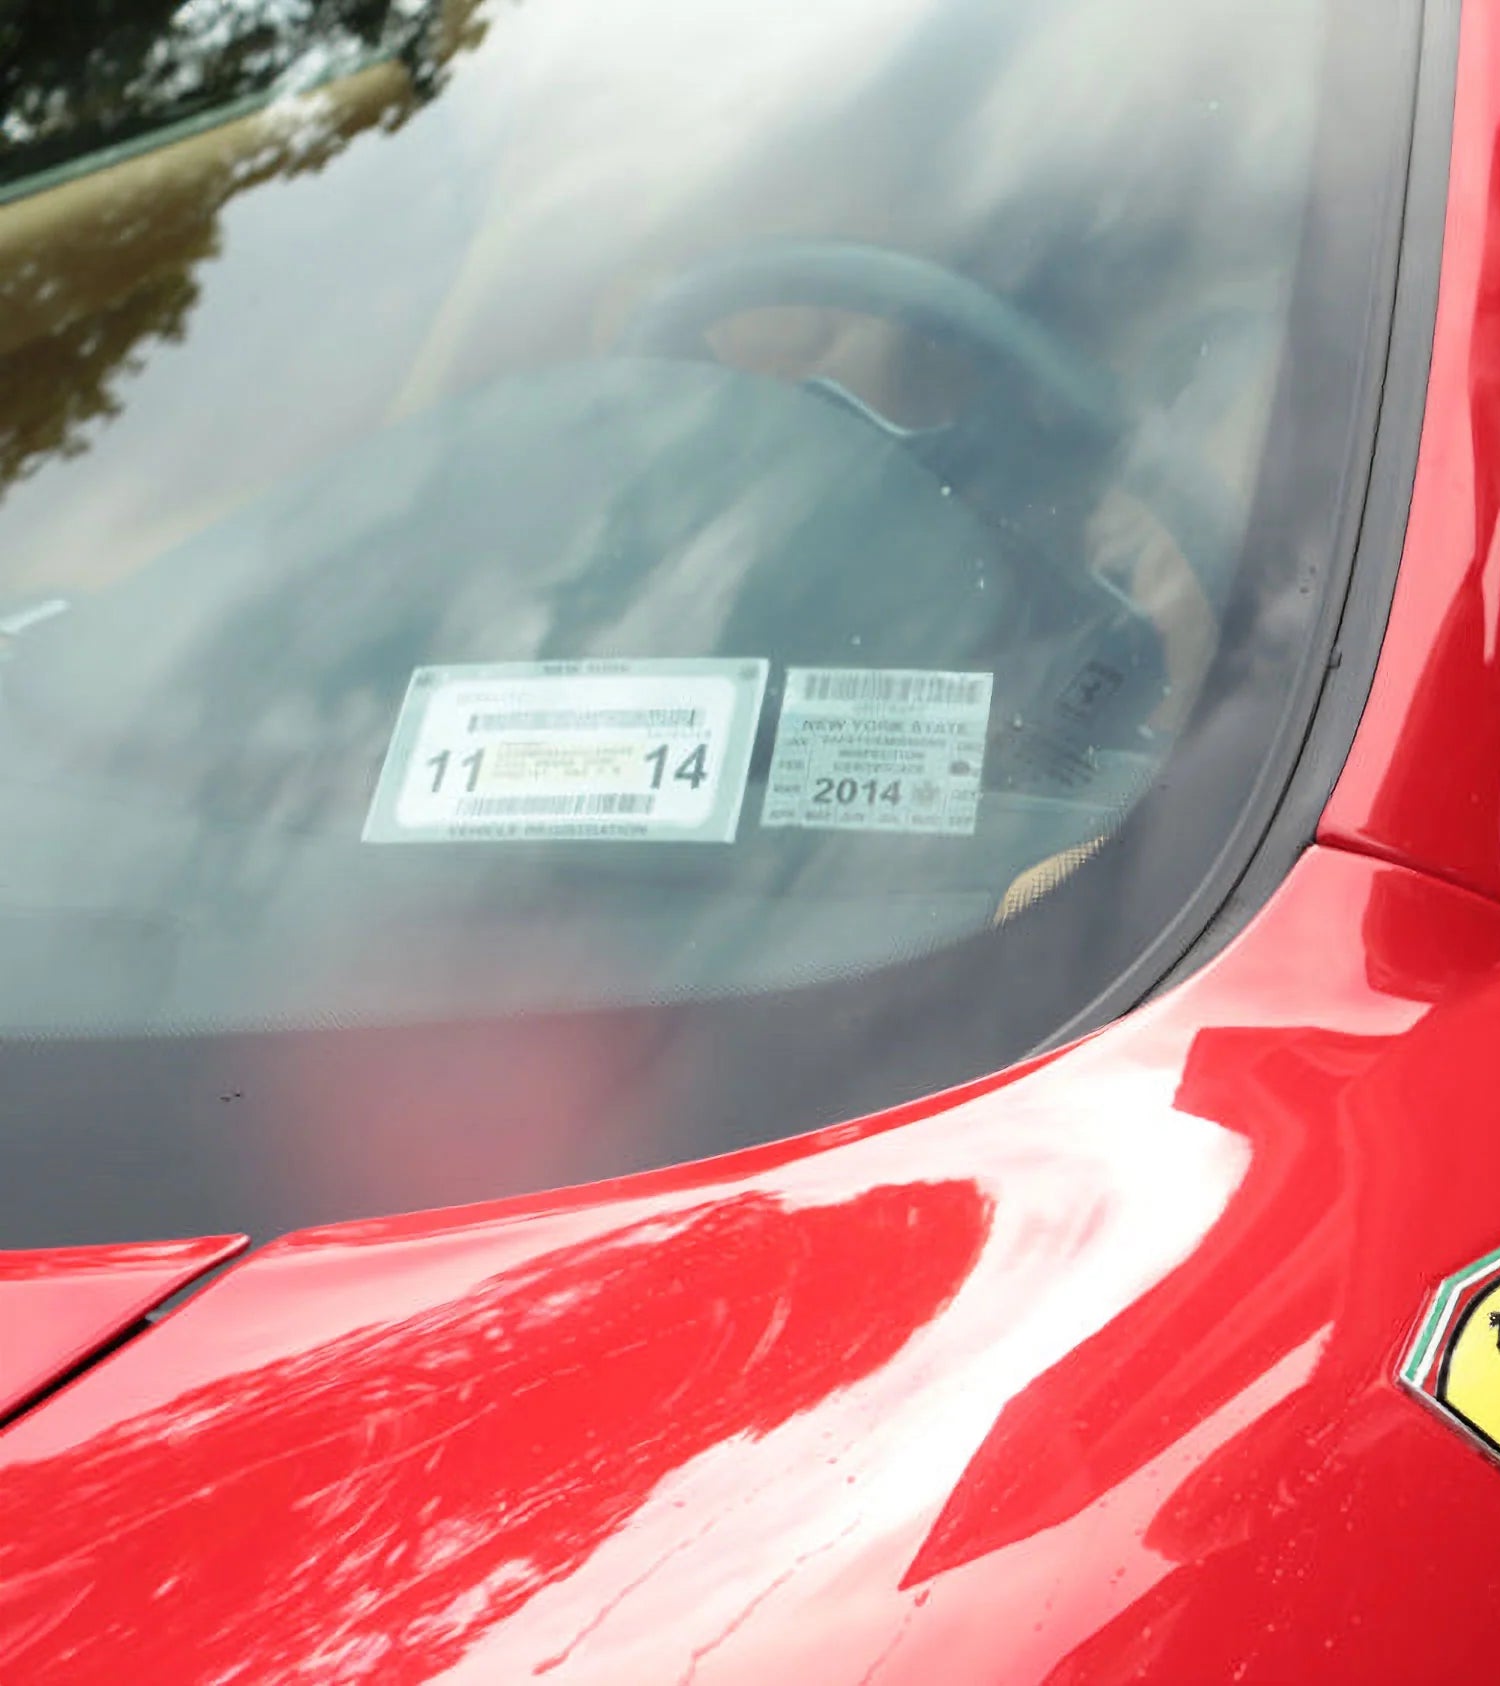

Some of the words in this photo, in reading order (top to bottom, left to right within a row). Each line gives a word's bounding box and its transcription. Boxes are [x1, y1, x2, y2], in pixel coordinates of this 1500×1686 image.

[426, 746, 485, 793] 11
[643, 743, 709, 790] 14
[813, 777, 902, 806] 2014
